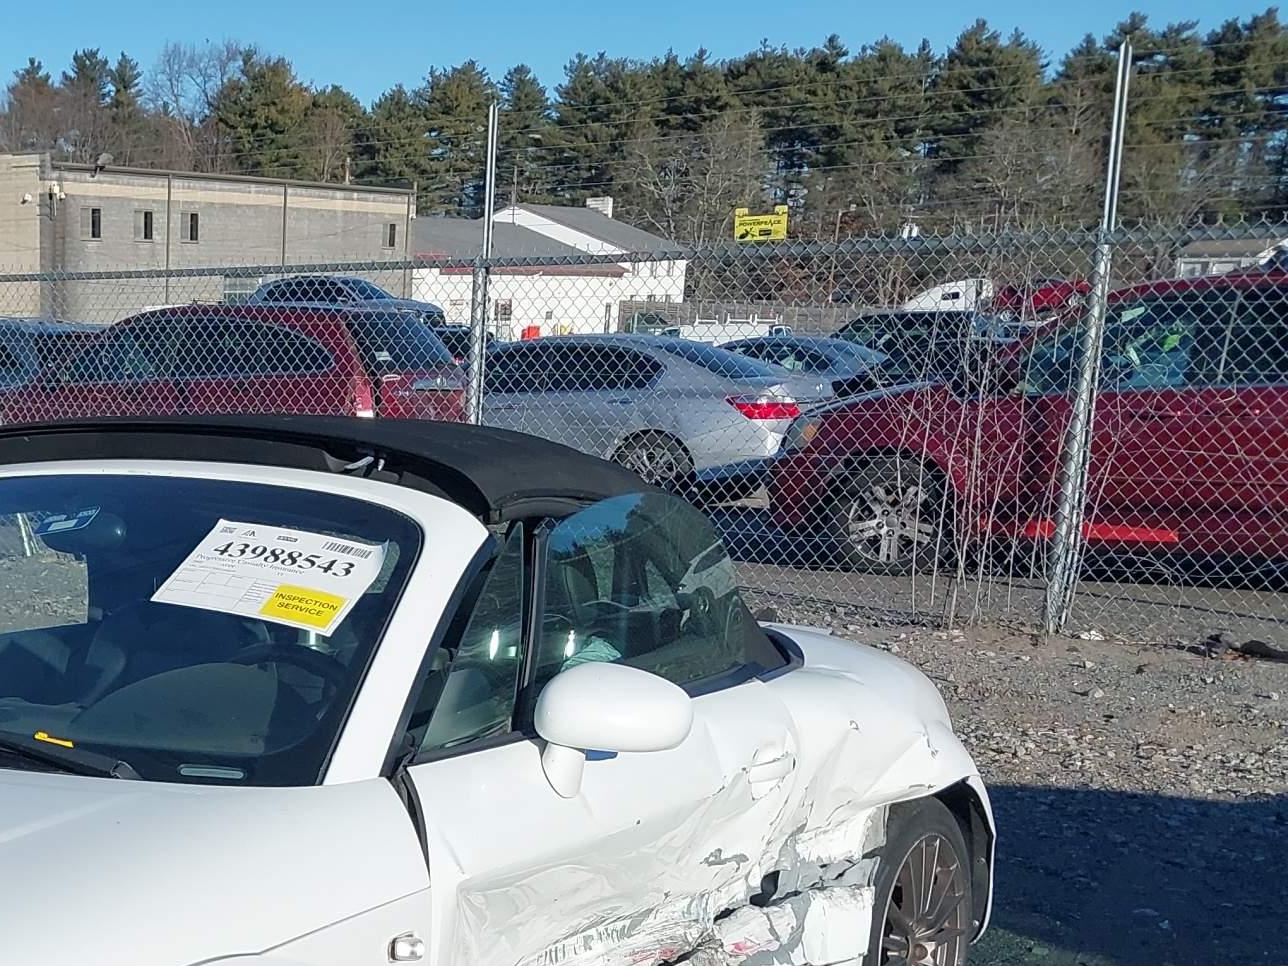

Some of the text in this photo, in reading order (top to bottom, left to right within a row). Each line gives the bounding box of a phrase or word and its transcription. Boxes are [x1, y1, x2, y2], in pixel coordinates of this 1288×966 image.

[213, 541, 355, 577] 43988543
[274, 592, 338, 612] INSPECTION
[276, 602, 324, 617] SERVICE
